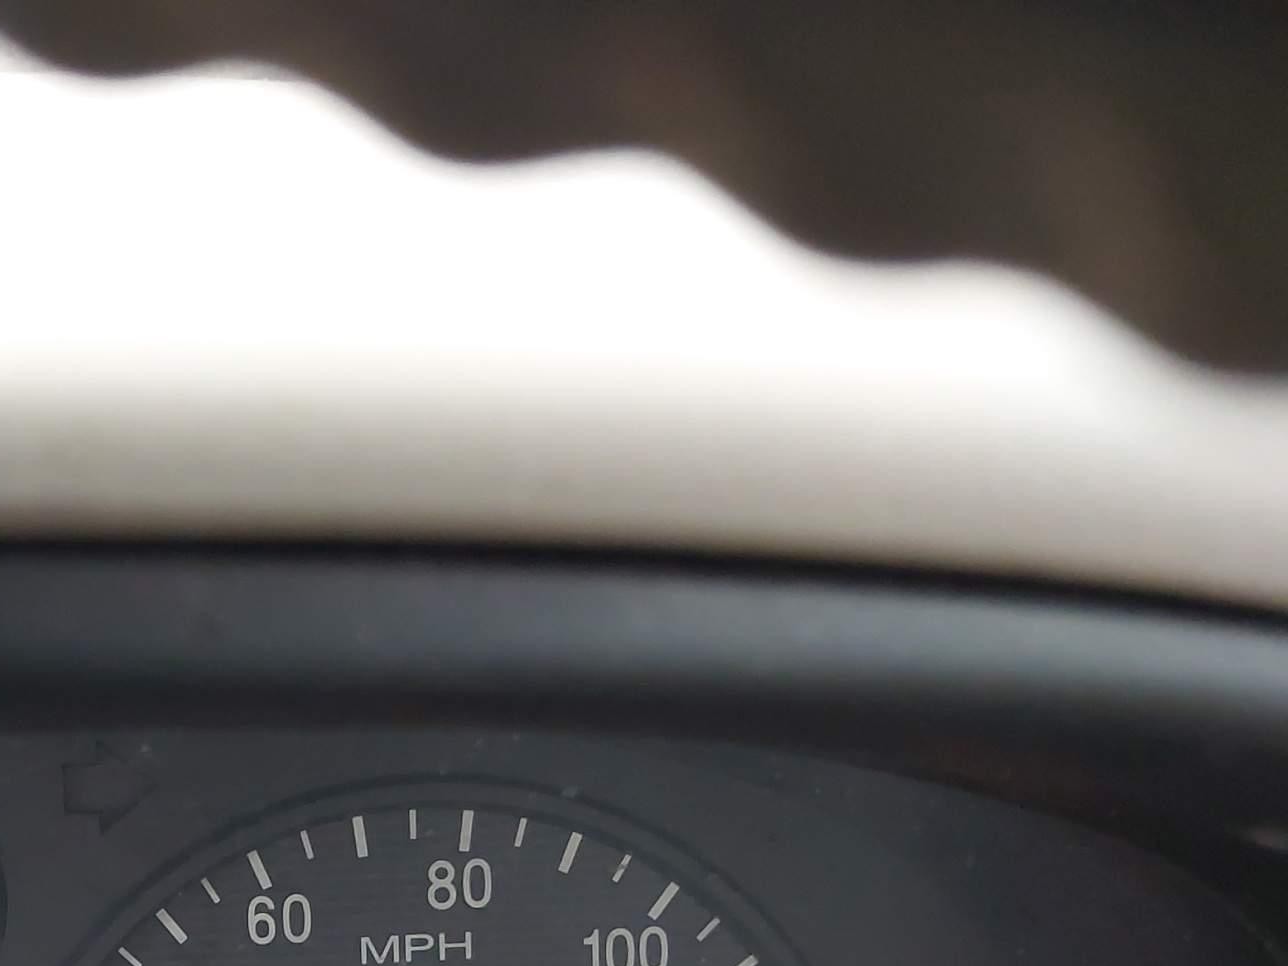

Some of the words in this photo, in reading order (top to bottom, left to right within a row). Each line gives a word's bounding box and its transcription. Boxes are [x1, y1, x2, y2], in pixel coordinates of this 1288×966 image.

[426, 857, 493, 911] 80
[246, 893, 312, 945] 60
[359, 931, 473, 965] MPH
